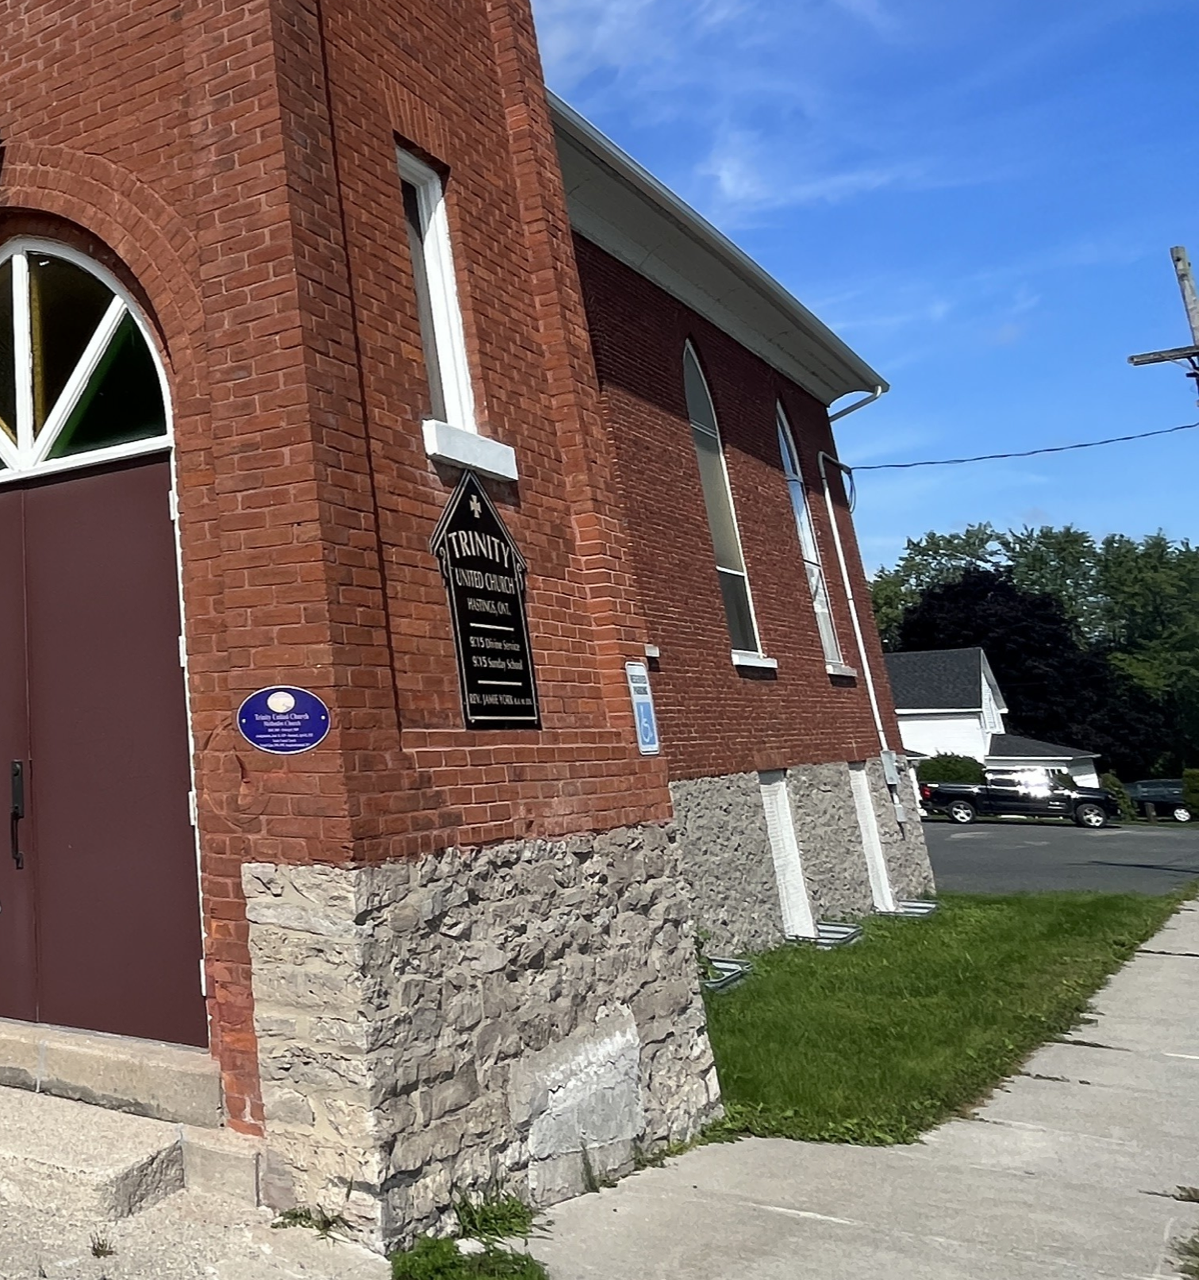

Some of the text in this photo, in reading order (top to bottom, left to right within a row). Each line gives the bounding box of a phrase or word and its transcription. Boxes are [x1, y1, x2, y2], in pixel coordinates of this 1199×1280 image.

[448, 530, 509, 568] TRINITY
[454, 567, 515, 595] UNITED CHURCH
[502, 639, 521, 651] Service
[506, 658, 523, 670] School
